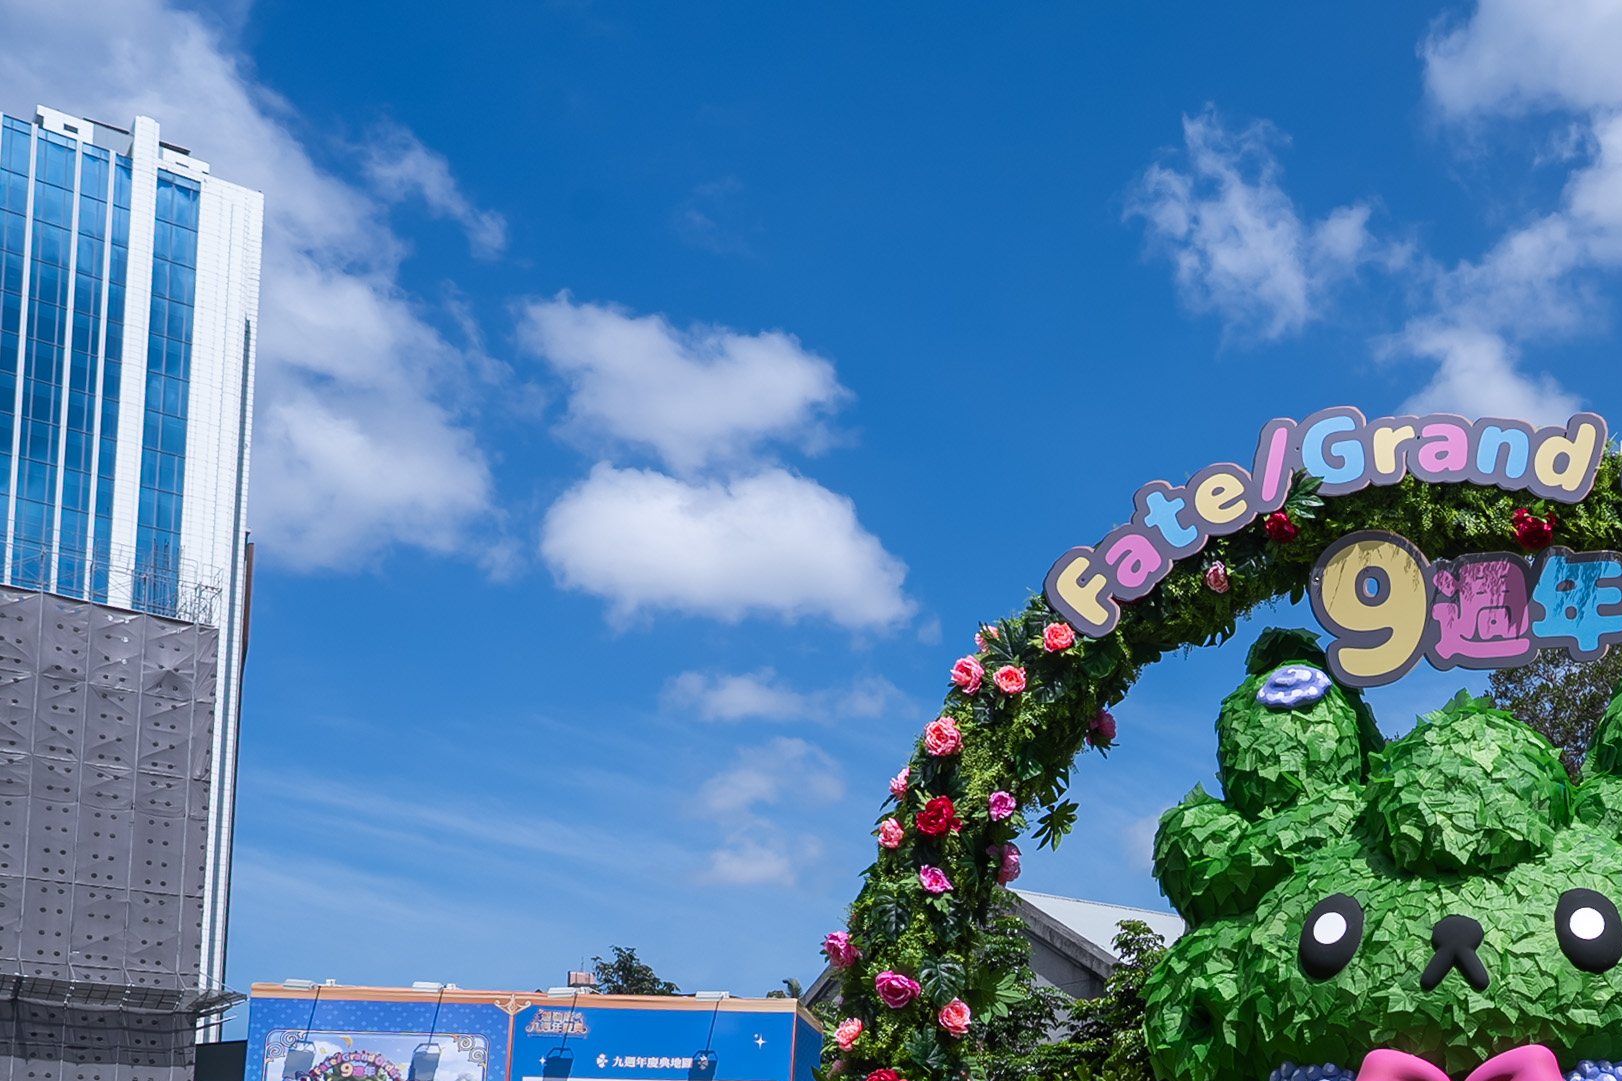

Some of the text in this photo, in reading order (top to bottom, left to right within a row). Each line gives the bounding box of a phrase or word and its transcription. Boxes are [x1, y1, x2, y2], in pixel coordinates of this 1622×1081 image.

[612, 1056, 693, 1069] 九週年慶典地圖
